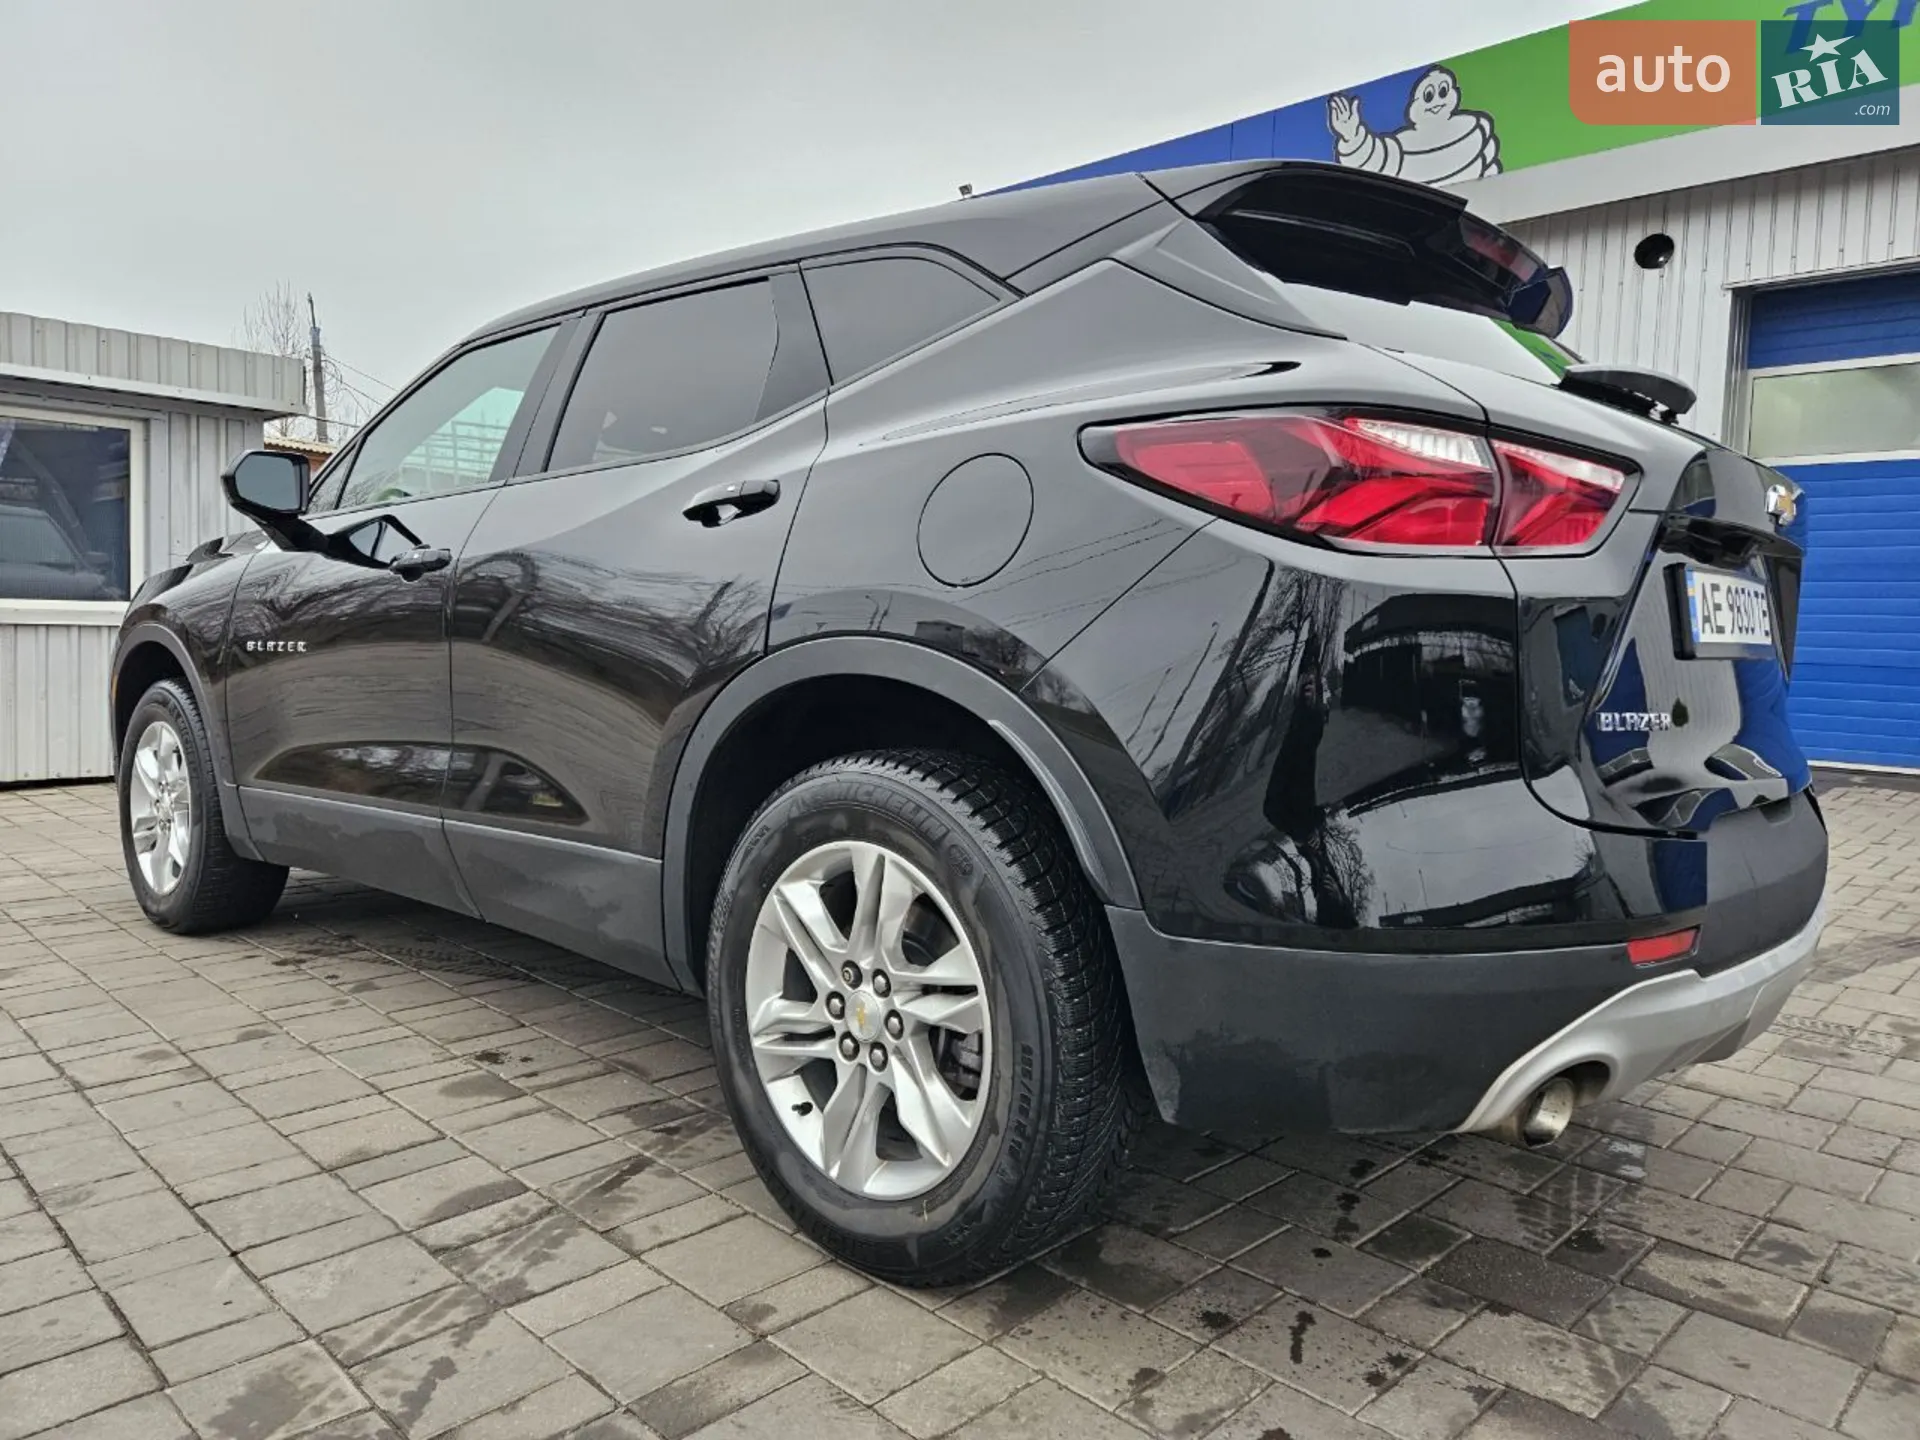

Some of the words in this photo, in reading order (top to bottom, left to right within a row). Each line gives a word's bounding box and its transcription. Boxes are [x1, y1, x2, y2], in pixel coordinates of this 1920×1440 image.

[1702, 581, 1726, 634] AE
[246, 640, 307, 652] BLAZER
[1599, 712, 1671, 732] BLAZER
